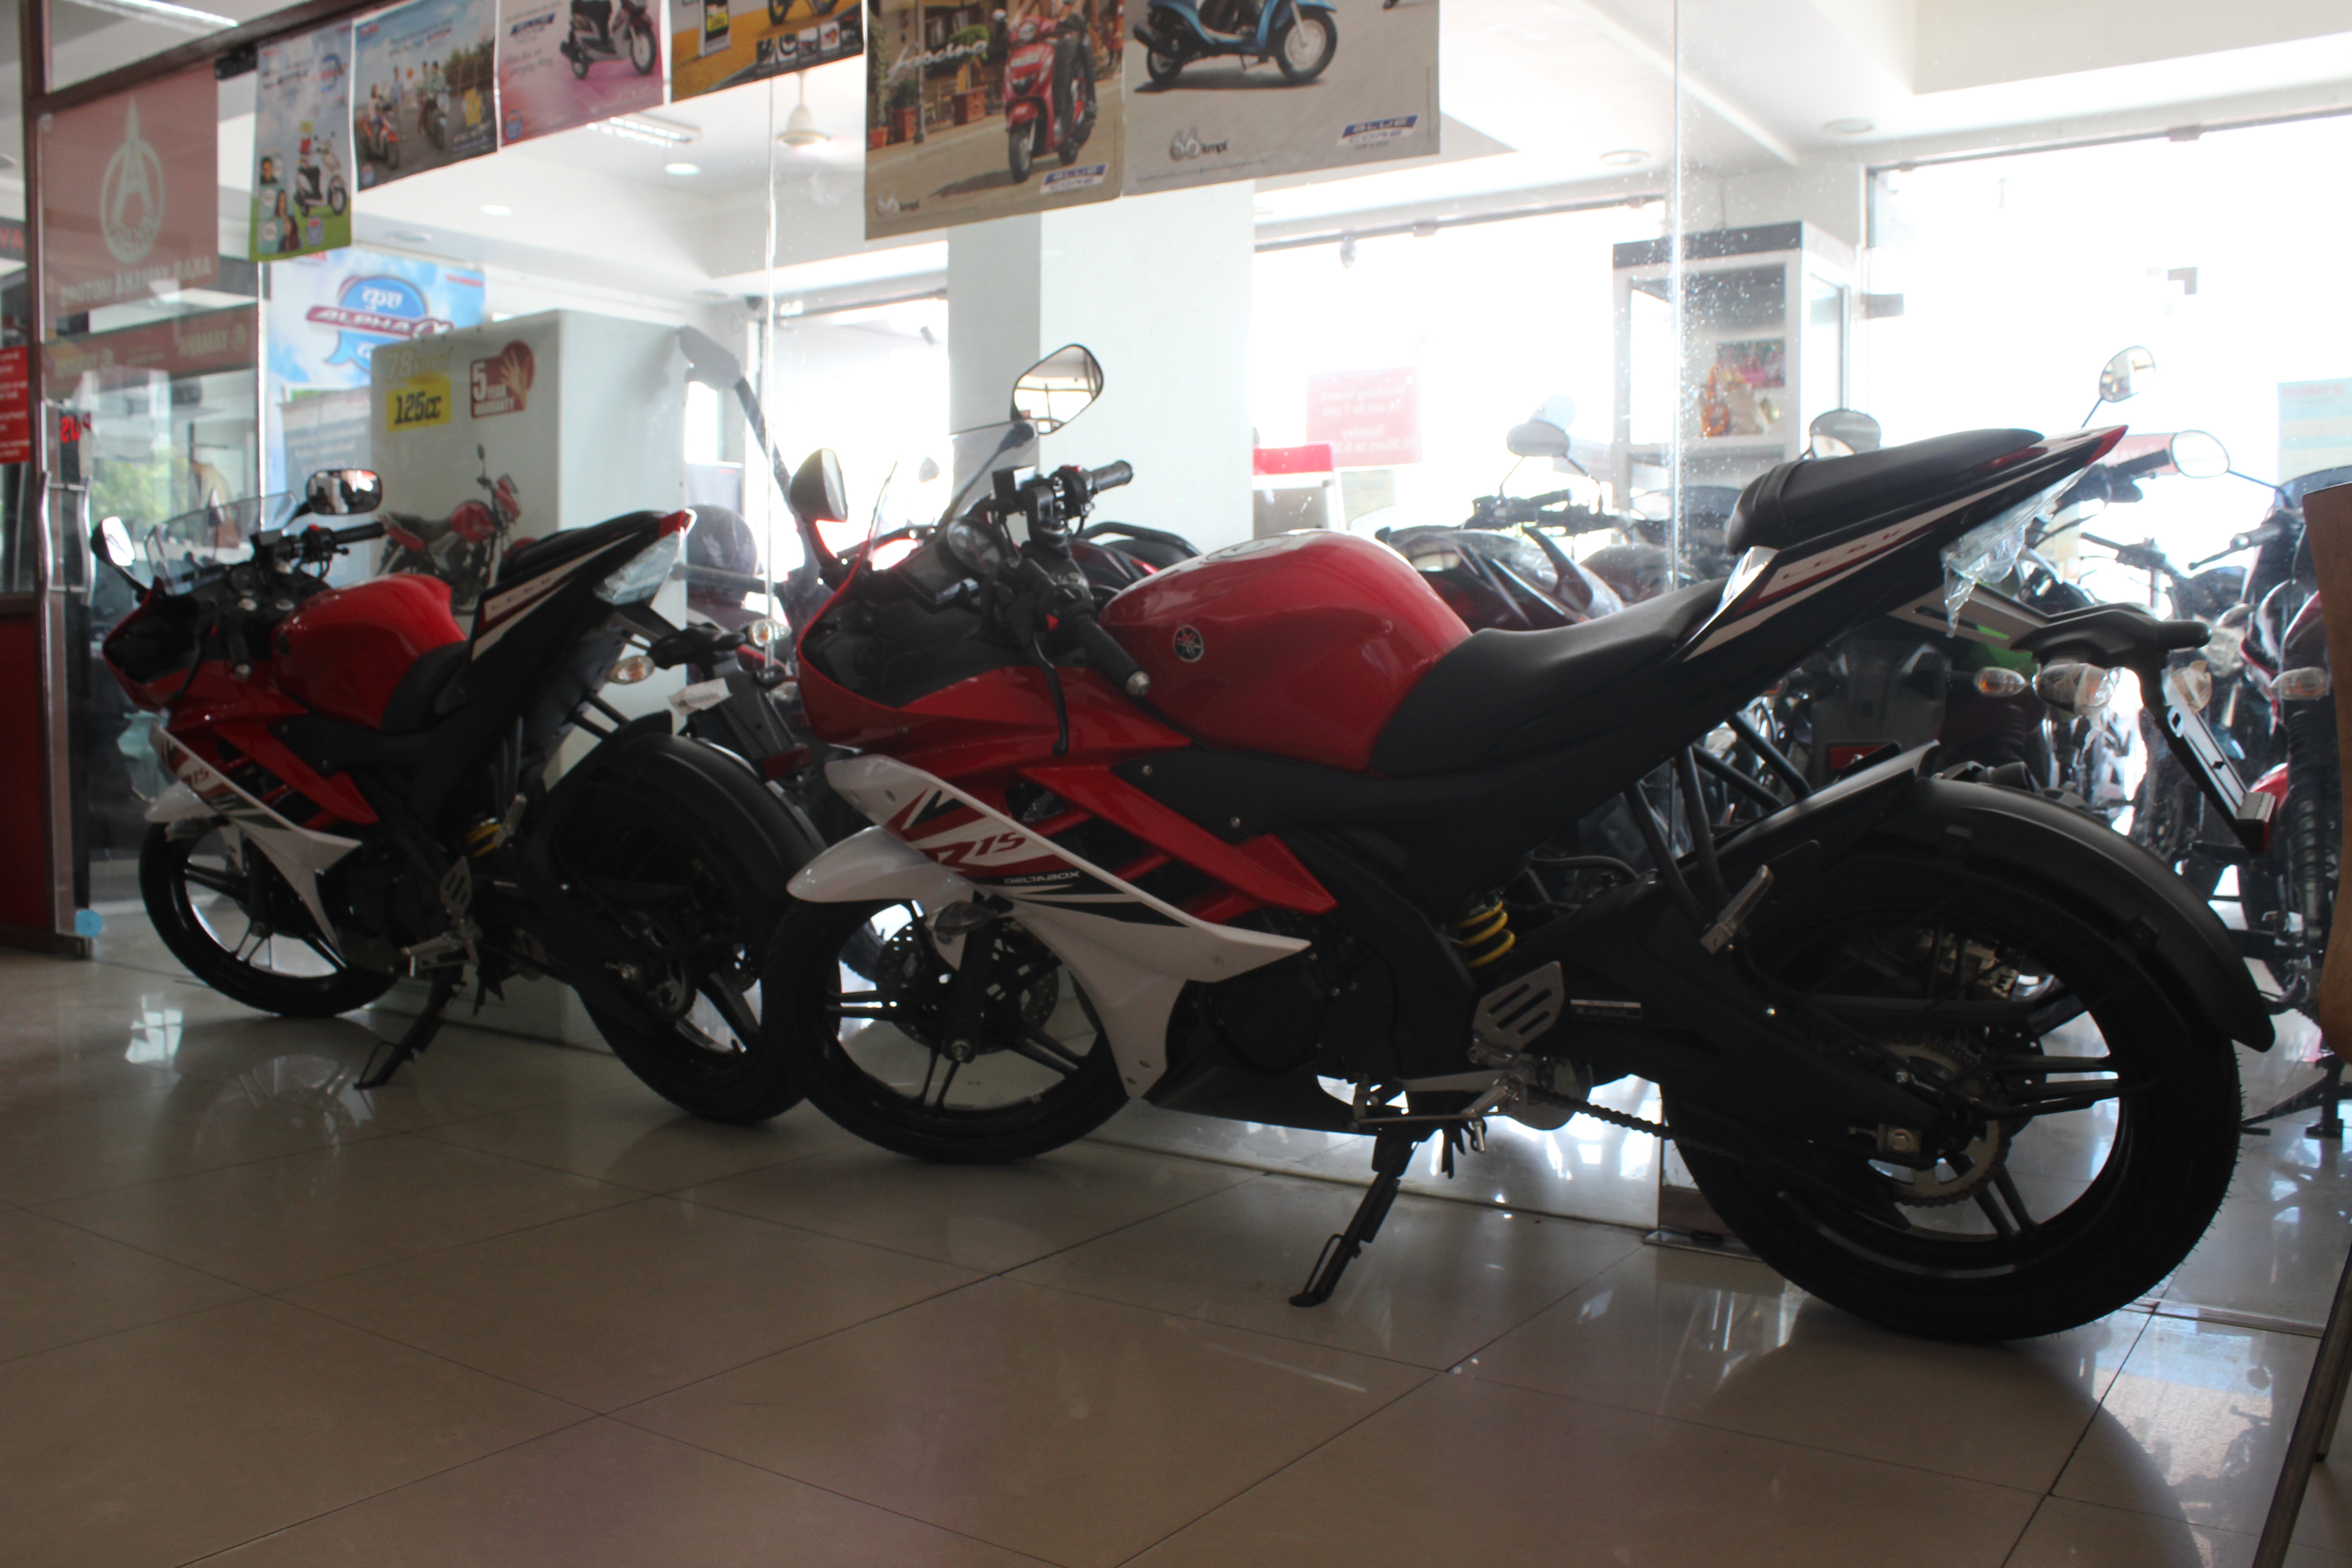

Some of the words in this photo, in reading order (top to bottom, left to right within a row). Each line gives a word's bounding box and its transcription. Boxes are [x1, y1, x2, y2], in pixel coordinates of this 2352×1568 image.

[1352, 118, 1407, 133] BLUE
[315, 309, 410, 332] ALPHA
[472, 363, 487, 402] 5
[394, 389, 441, 425] 125cc
[1004, 870, 1080, 884] DELTABOX
